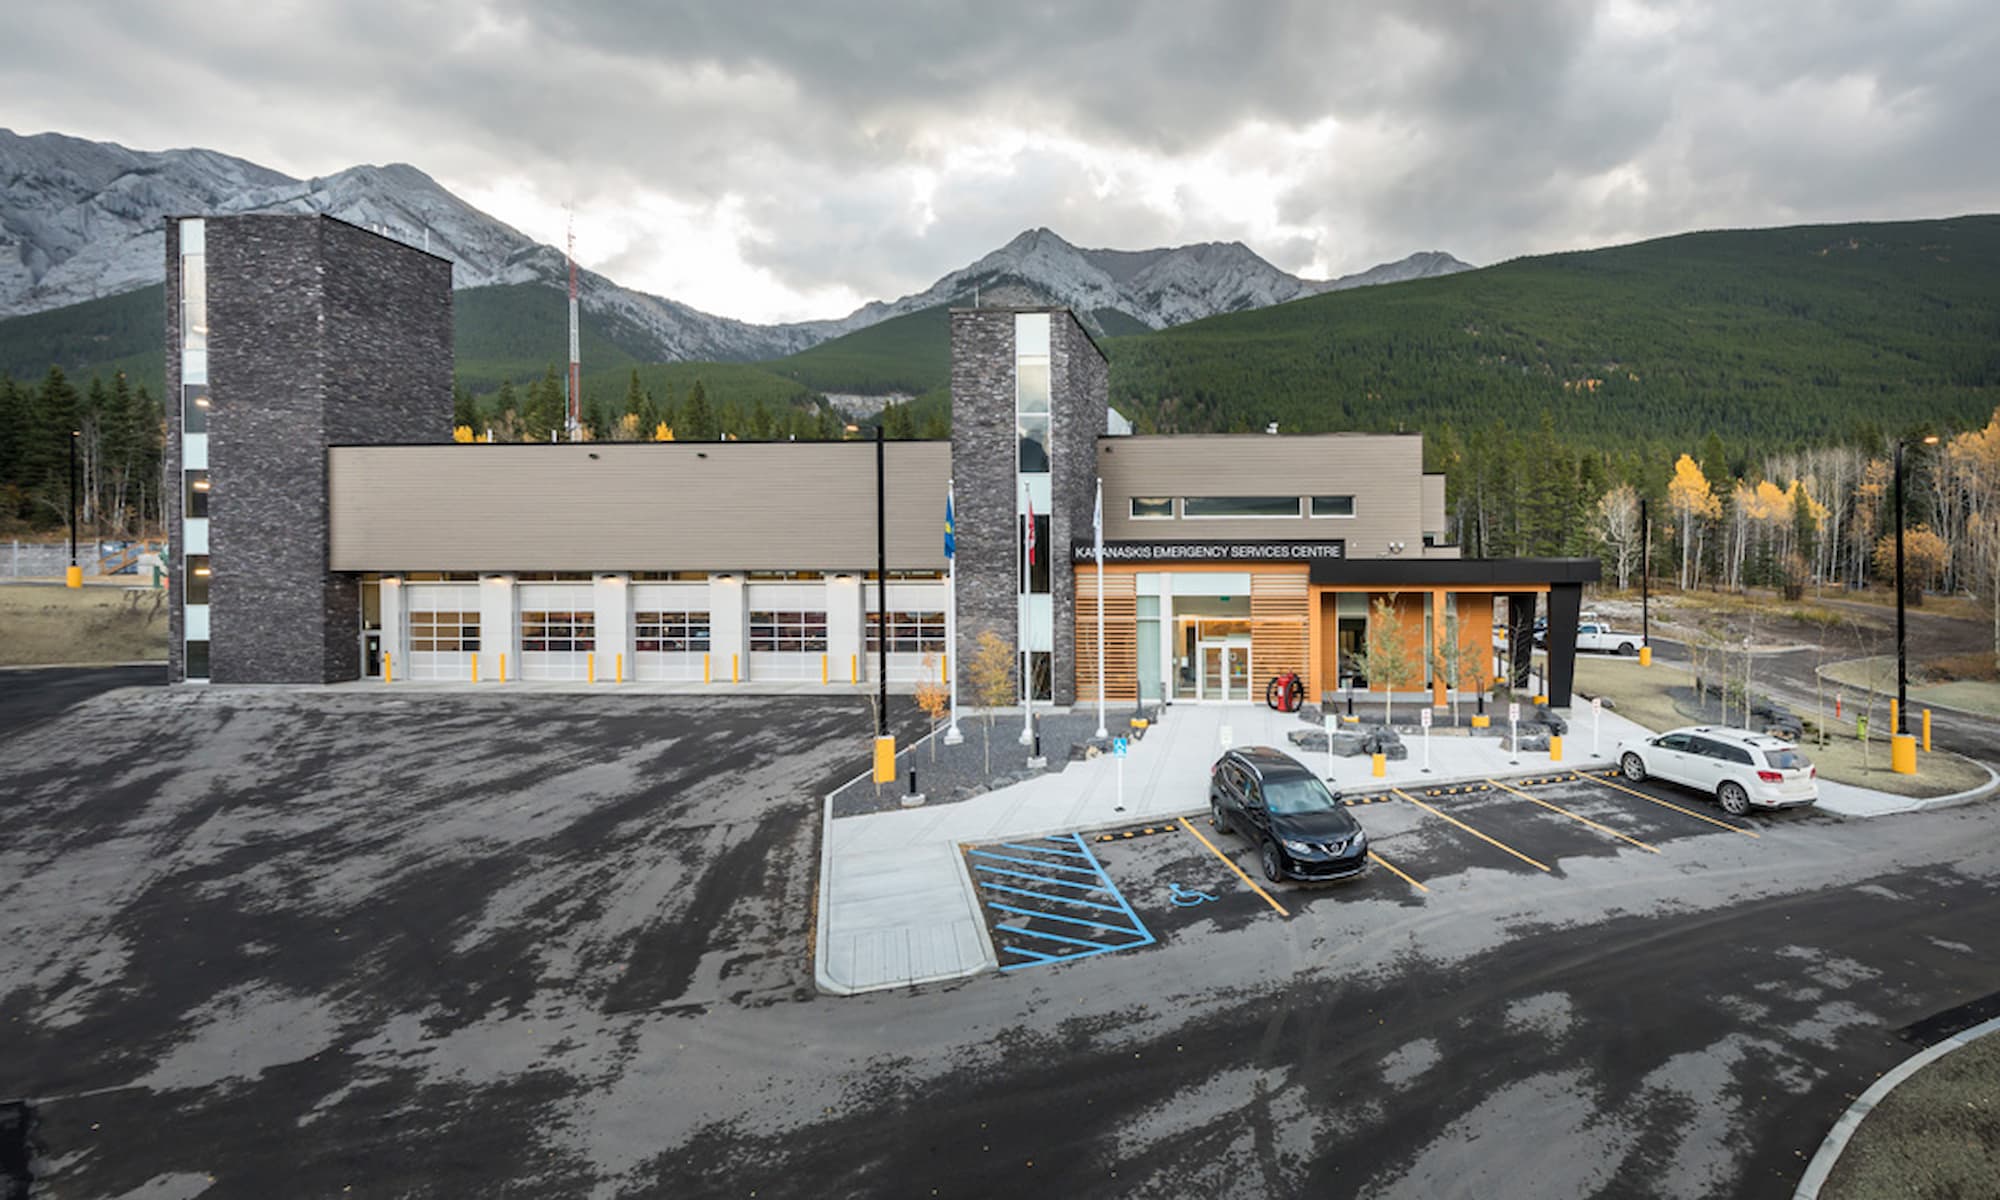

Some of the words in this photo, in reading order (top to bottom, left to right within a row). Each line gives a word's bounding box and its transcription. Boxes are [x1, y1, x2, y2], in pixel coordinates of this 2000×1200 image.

[1075, 546, 1151, 558] KAANASKIS
[1153, 546, 1229, 558] EMERGENCY
[1231, 546, 1289, 558] SERVICES
[1291, 546, 1340, 558] CENTRE
